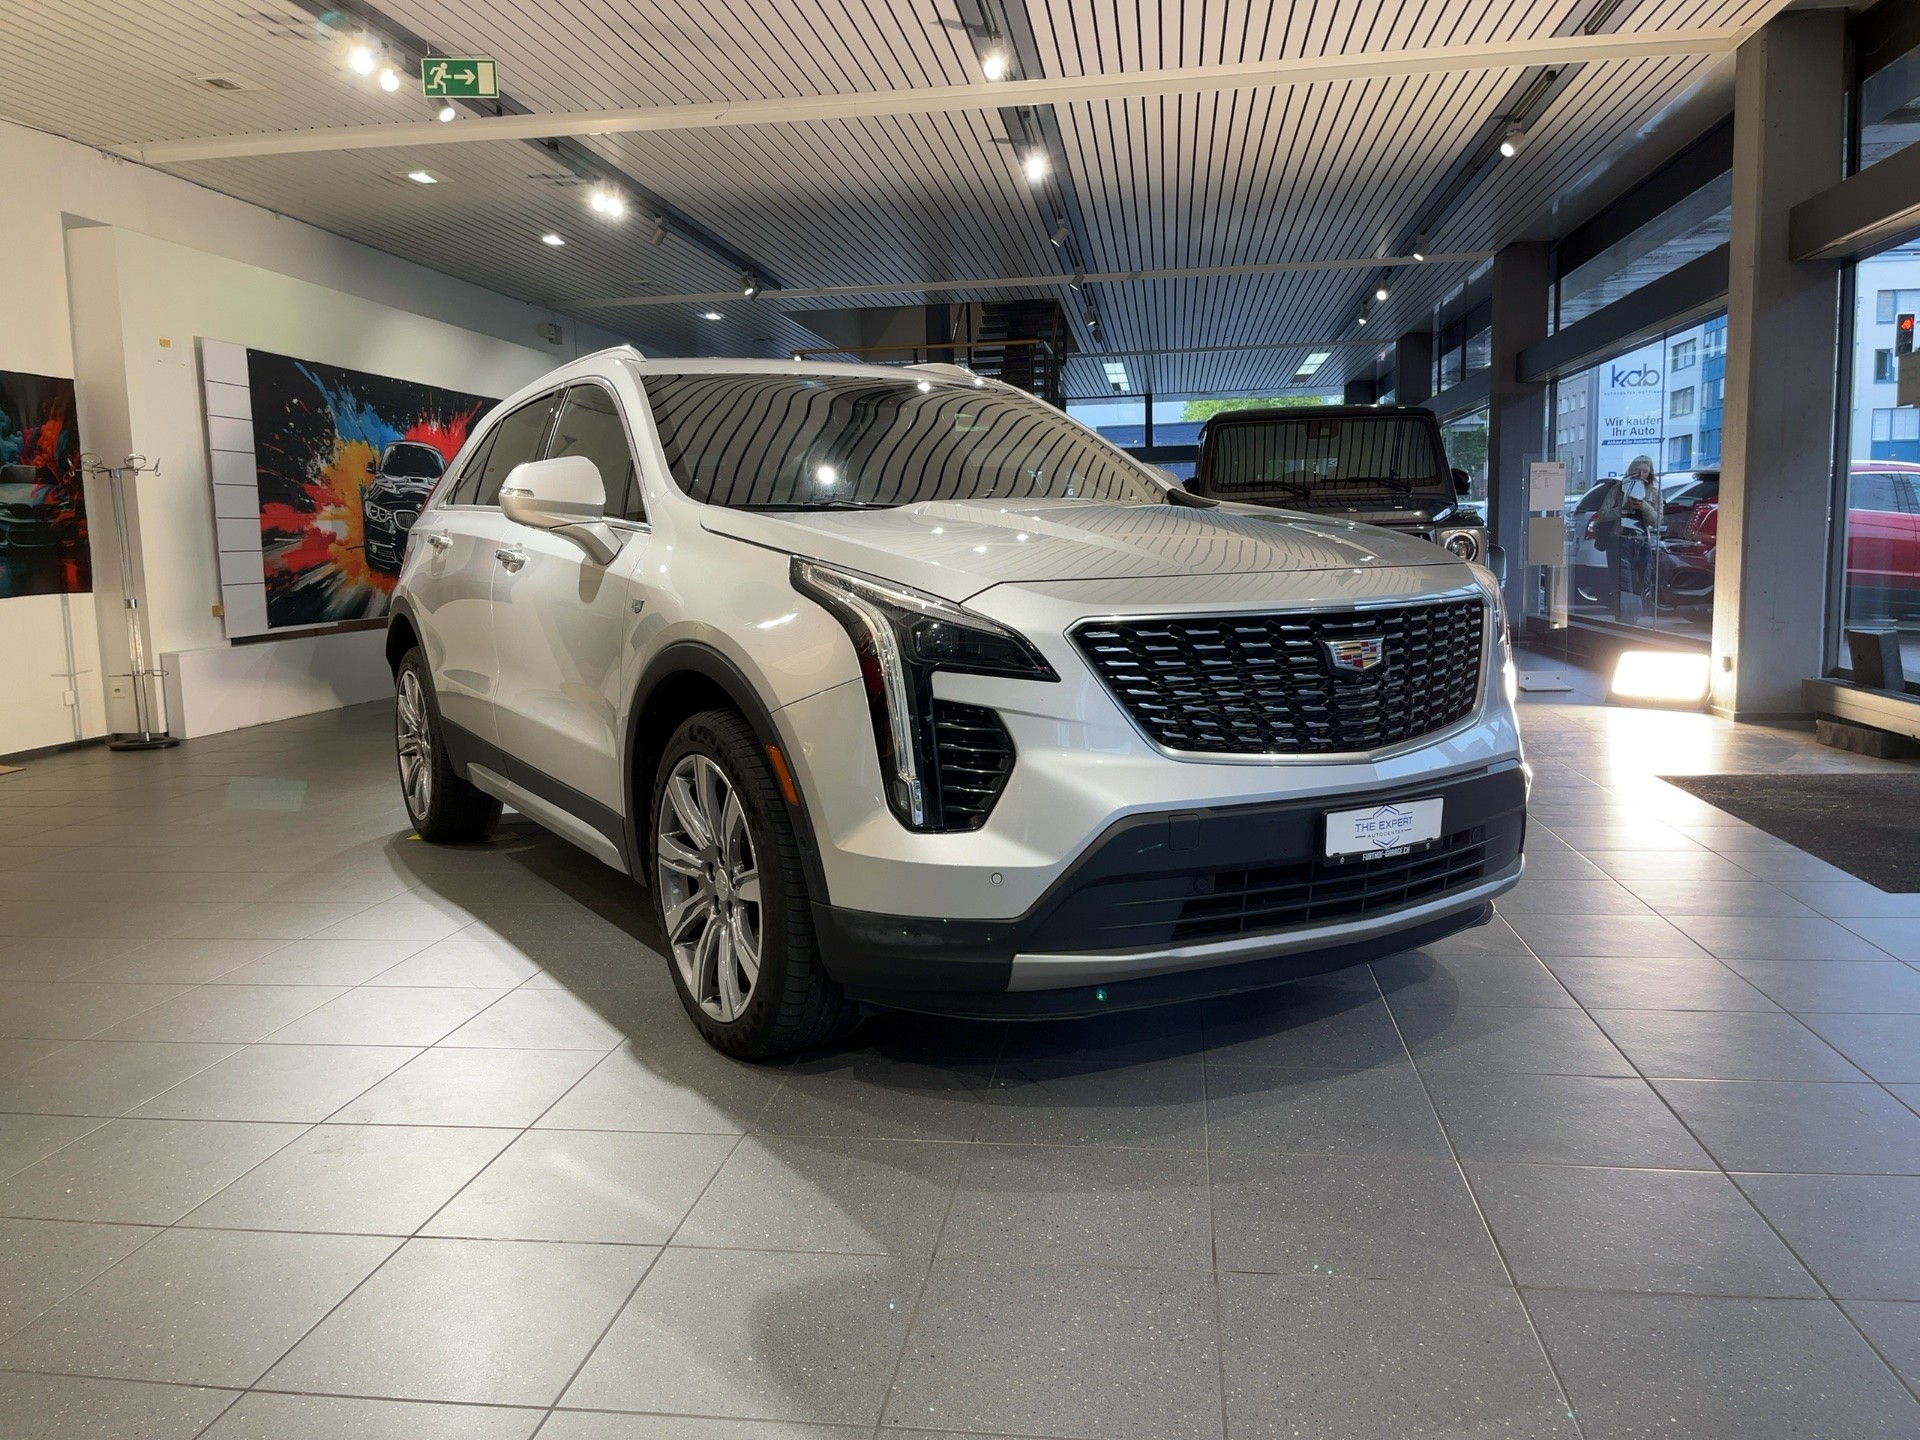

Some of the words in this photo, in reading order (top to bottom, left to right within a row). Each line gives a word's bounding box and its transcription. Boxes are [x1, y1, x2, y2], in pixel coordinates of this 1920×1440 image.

[1605, 417, 1623, 427] Wir
[1612, 427, 1627, 437] Ihr
[1630, 427, 1655, 436] Auto
[1355, 822, 1376, 832] THE
[1378, 816, 1413, 830] EXPERT
[1367, 829, 1404, 838] AUTOCENTER
